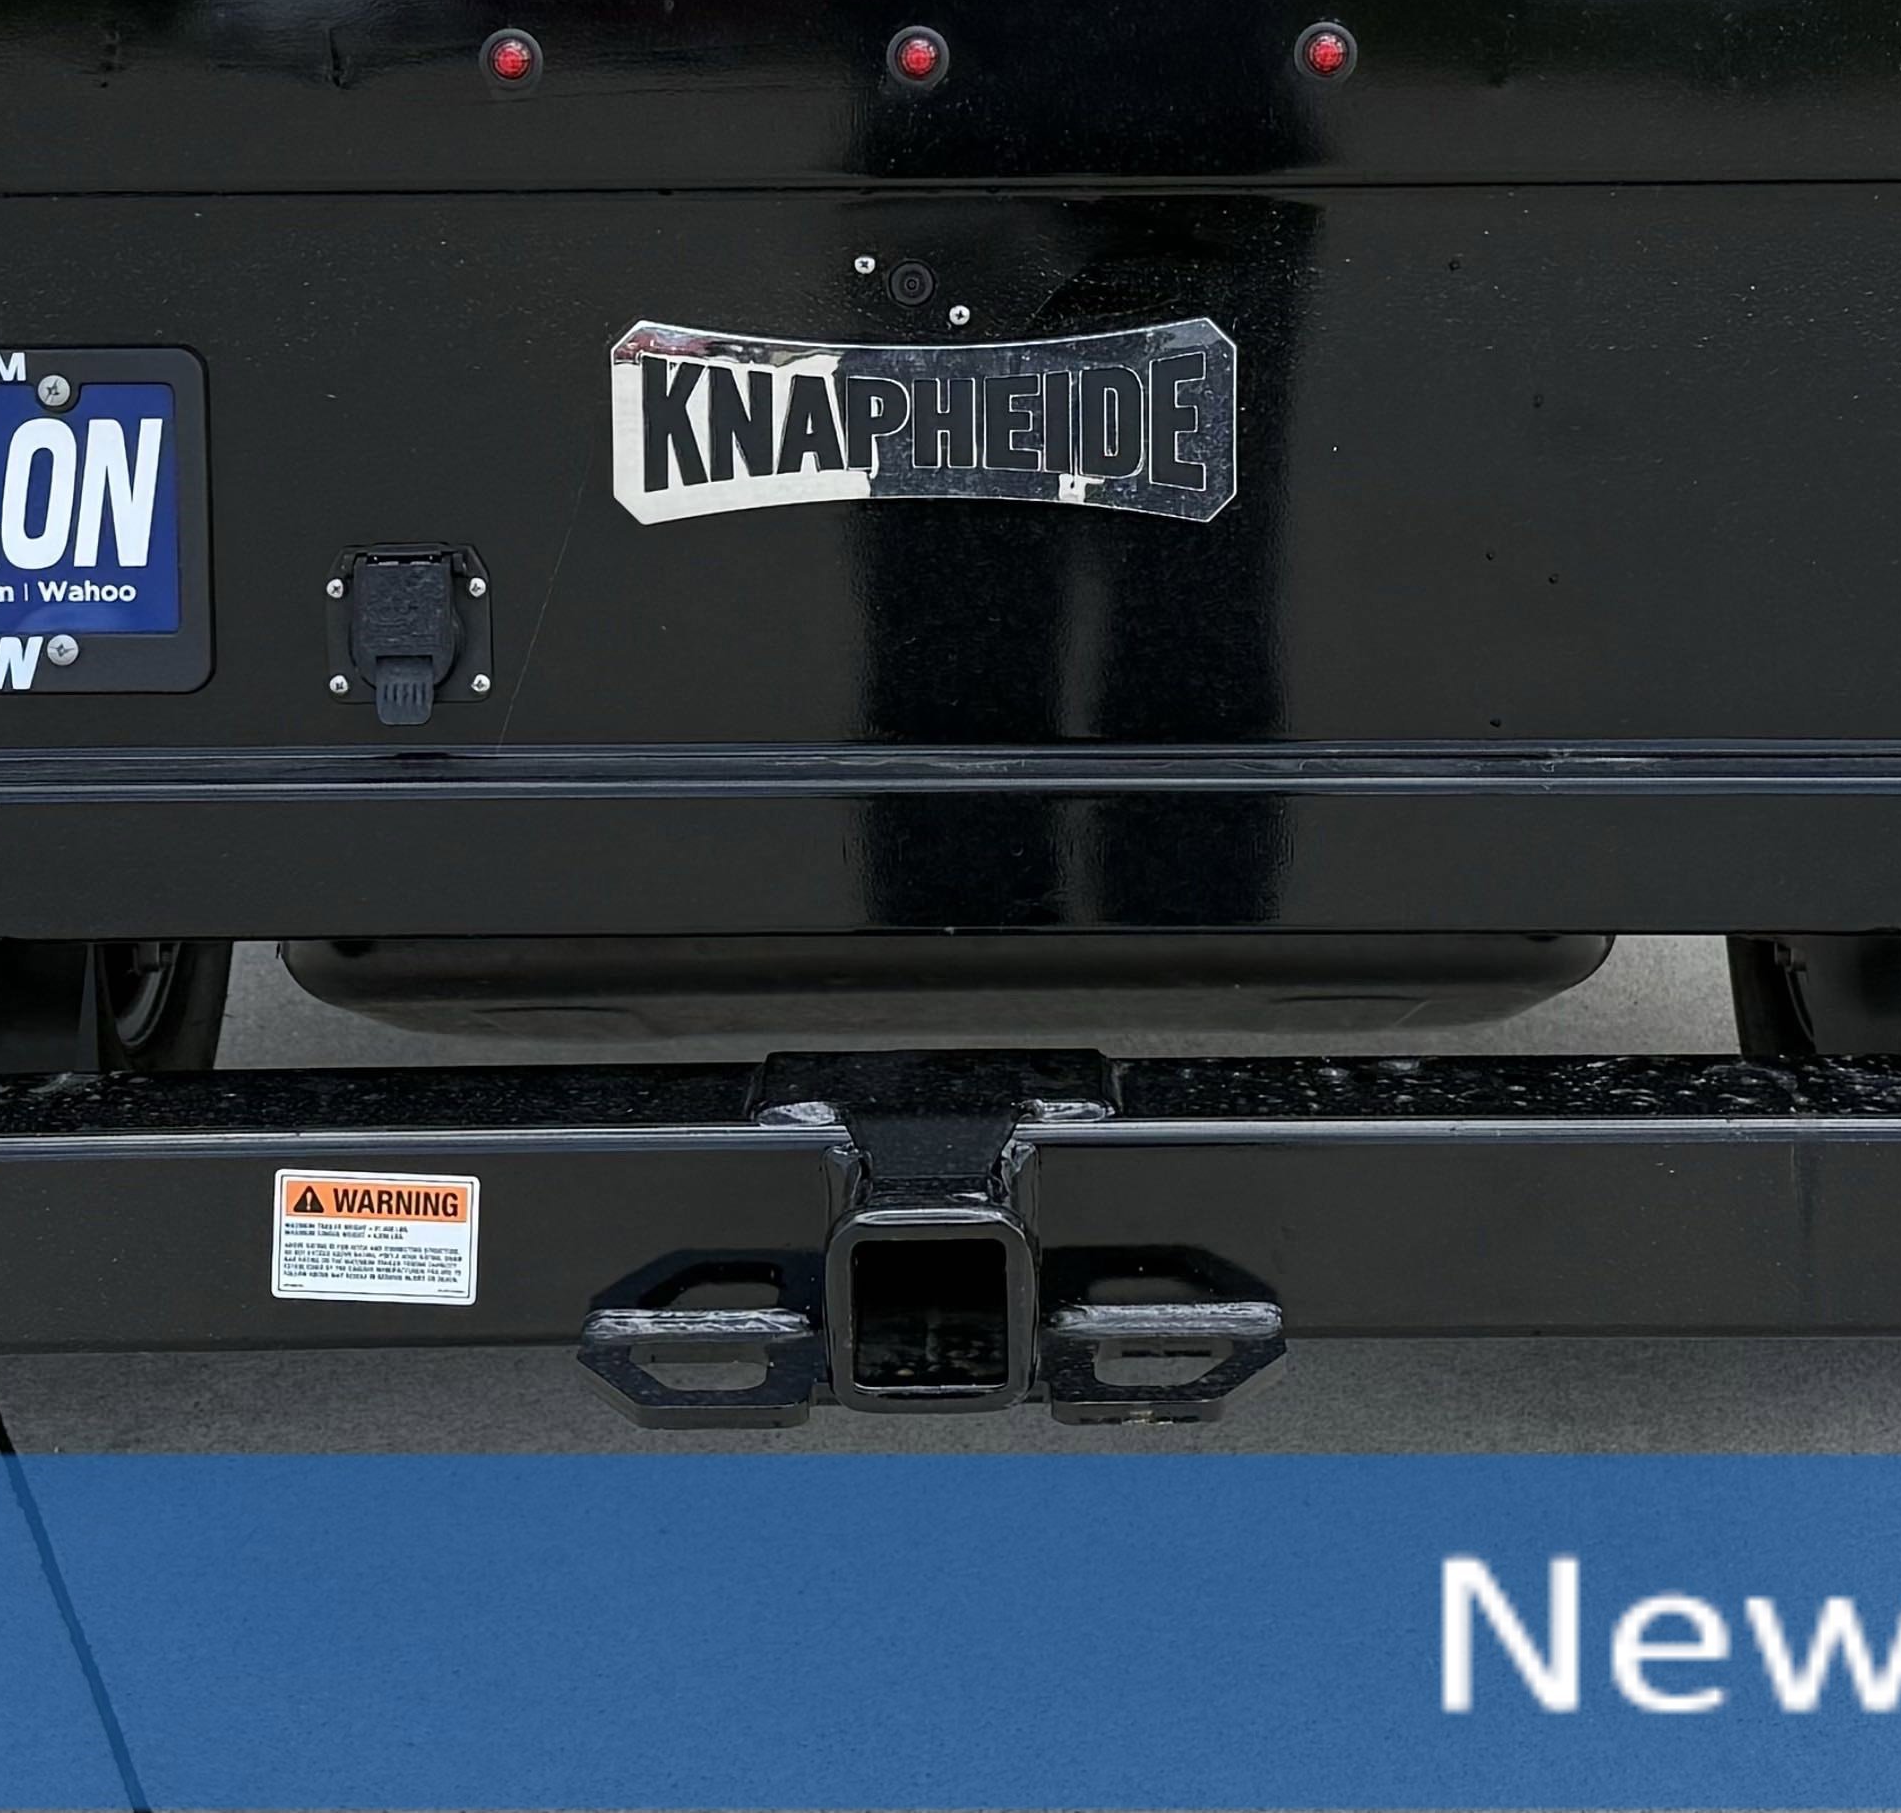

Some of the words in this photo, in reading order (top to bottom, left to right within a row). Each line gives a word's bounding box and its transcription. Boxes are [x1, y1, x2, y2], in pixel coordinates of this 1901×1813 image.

[642, 352, 1206, 494] KNAPHEIDE
[37, 579, 137, 603] Wahoo
[333, 1188, 459, 1217] WARNING
